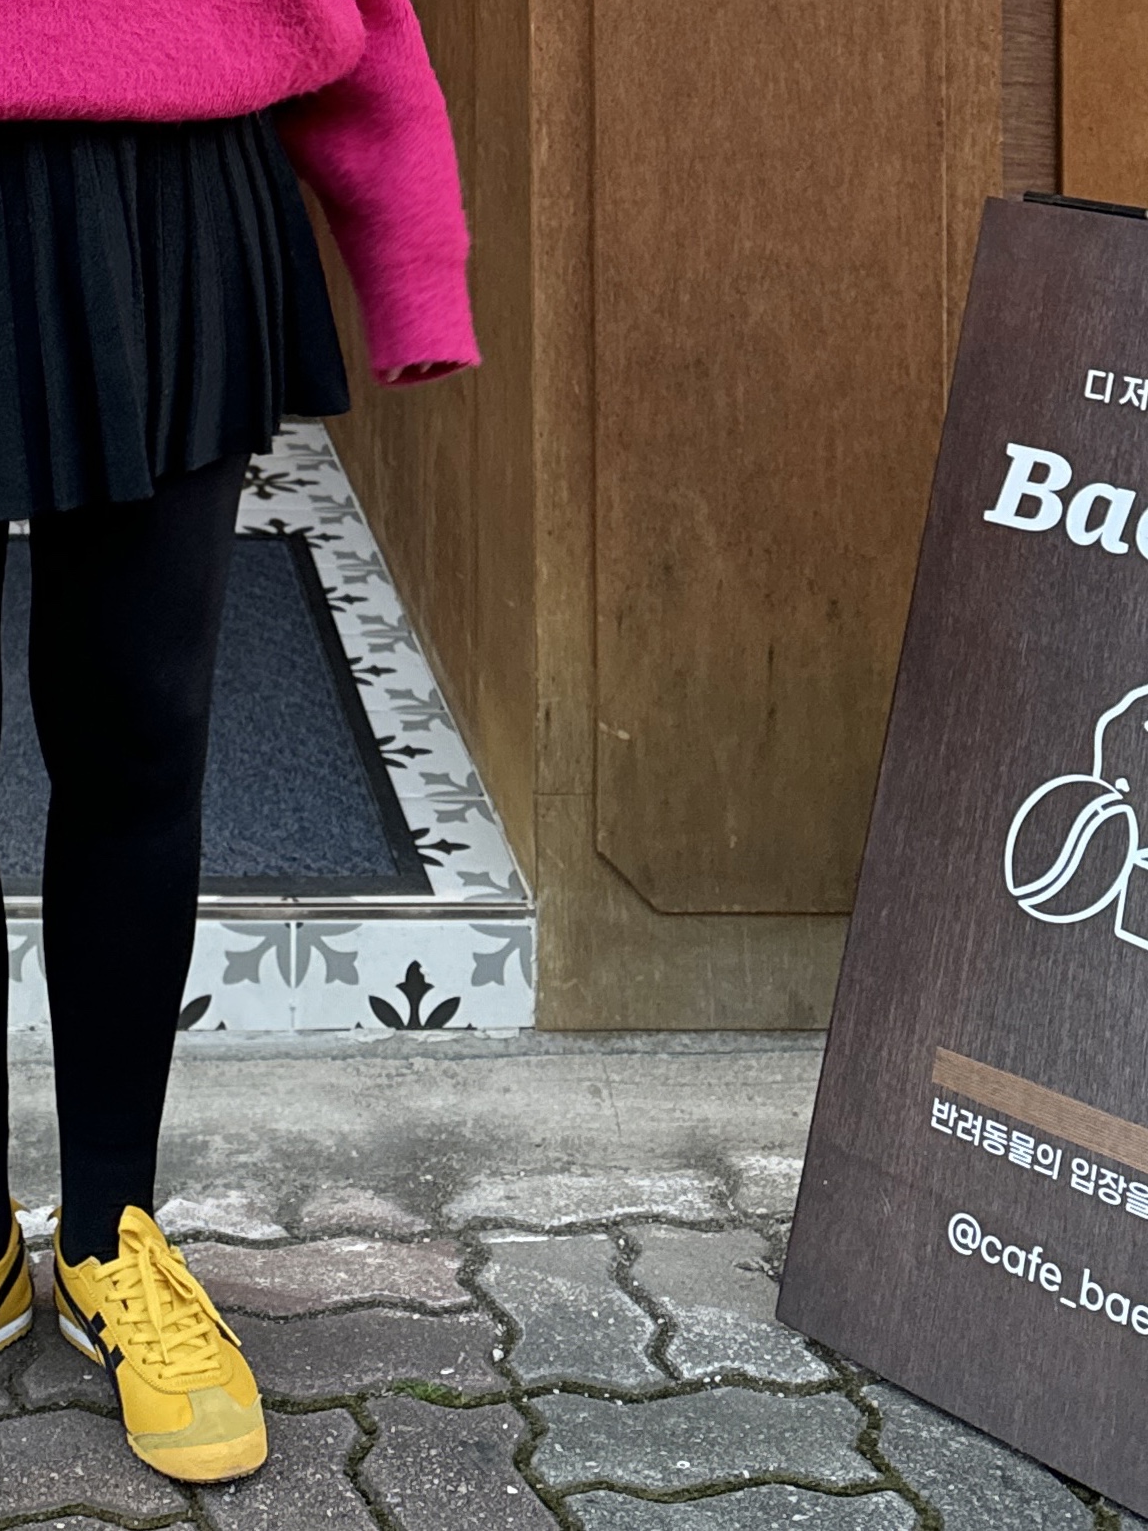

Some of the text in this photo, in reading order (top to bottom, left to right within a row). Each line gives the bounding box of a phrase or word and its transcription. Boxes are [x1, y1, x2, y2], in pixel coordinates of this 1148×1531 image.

[1084, 368, 1148, 411] 디저
[930, 1097, 1148, 1220] 반려동물의 입장을
[947, 1212, 1148, 1336] @cafe_bae
